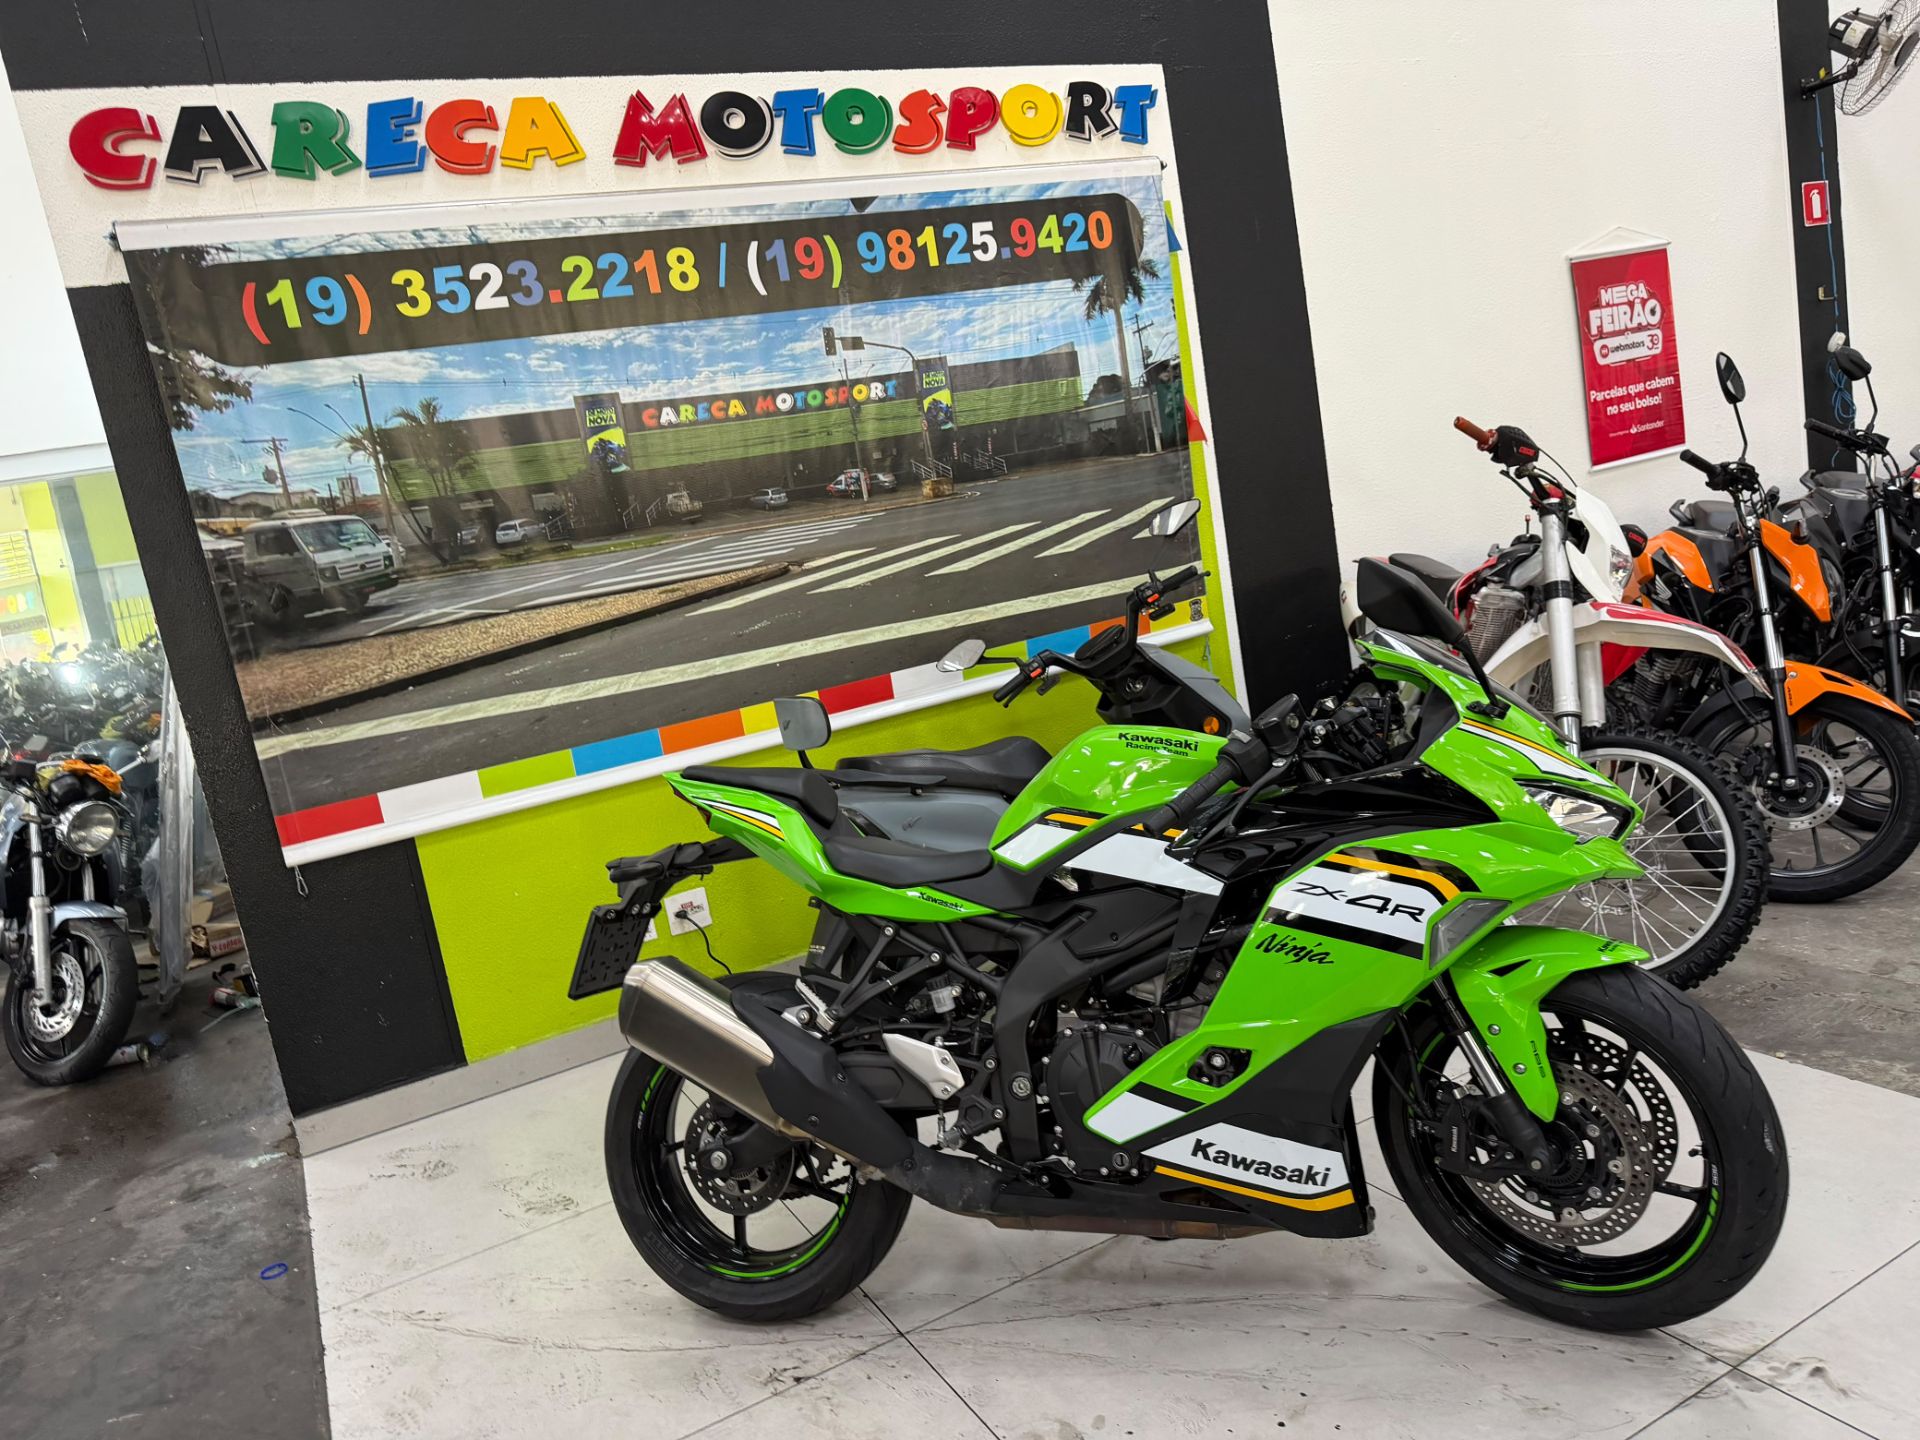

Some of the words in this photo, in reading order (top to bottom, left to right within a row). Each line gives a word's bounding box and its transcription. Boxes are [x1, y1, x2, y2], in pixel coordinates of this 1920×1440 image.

[69, 96, 587, 191] CARECA
[612, 80, 1178, 168] MOTOSPORT
[242, 274, 372, 345] (19)
[391, 247, 700, 319] 3523.2218
[747, 234, 843, 296] (19)
[857, 210, 1113, 274] 98125.9420
[1600, 282, 1649, 307] MEGA
[1588, 298, 1662, 337] FEIRÃO
[1610, 339, 1646, 354] webmotors
[1590, 385, 1628, 403] Parcelas
[1628, 381, 1645, 396] que
[1645, 375, 1675, 391] cabem
[641, 398, 748, 428] CARECA
[754, 379, 898, 415] MOTOSPORT
[1606, 405, 1619, 416] no
[1619, 400, 1635, 413] seu
[1635, 392, 1662, 409] bolso!
[589, 414, 616, 426] NOVA
[1636, 419, 1665, 433] Santander
[1118, 732, 1199, 752] Kawasaki
[1126, 741, 1161, 753] Racing
[1163, 746, 1189, 757] Team
[1290, 881, 1427, 924] ZX-4R
[1255, 932, 1335, 965] Ninja
[1190, 1137, 1332, 1187] Kawasaki
